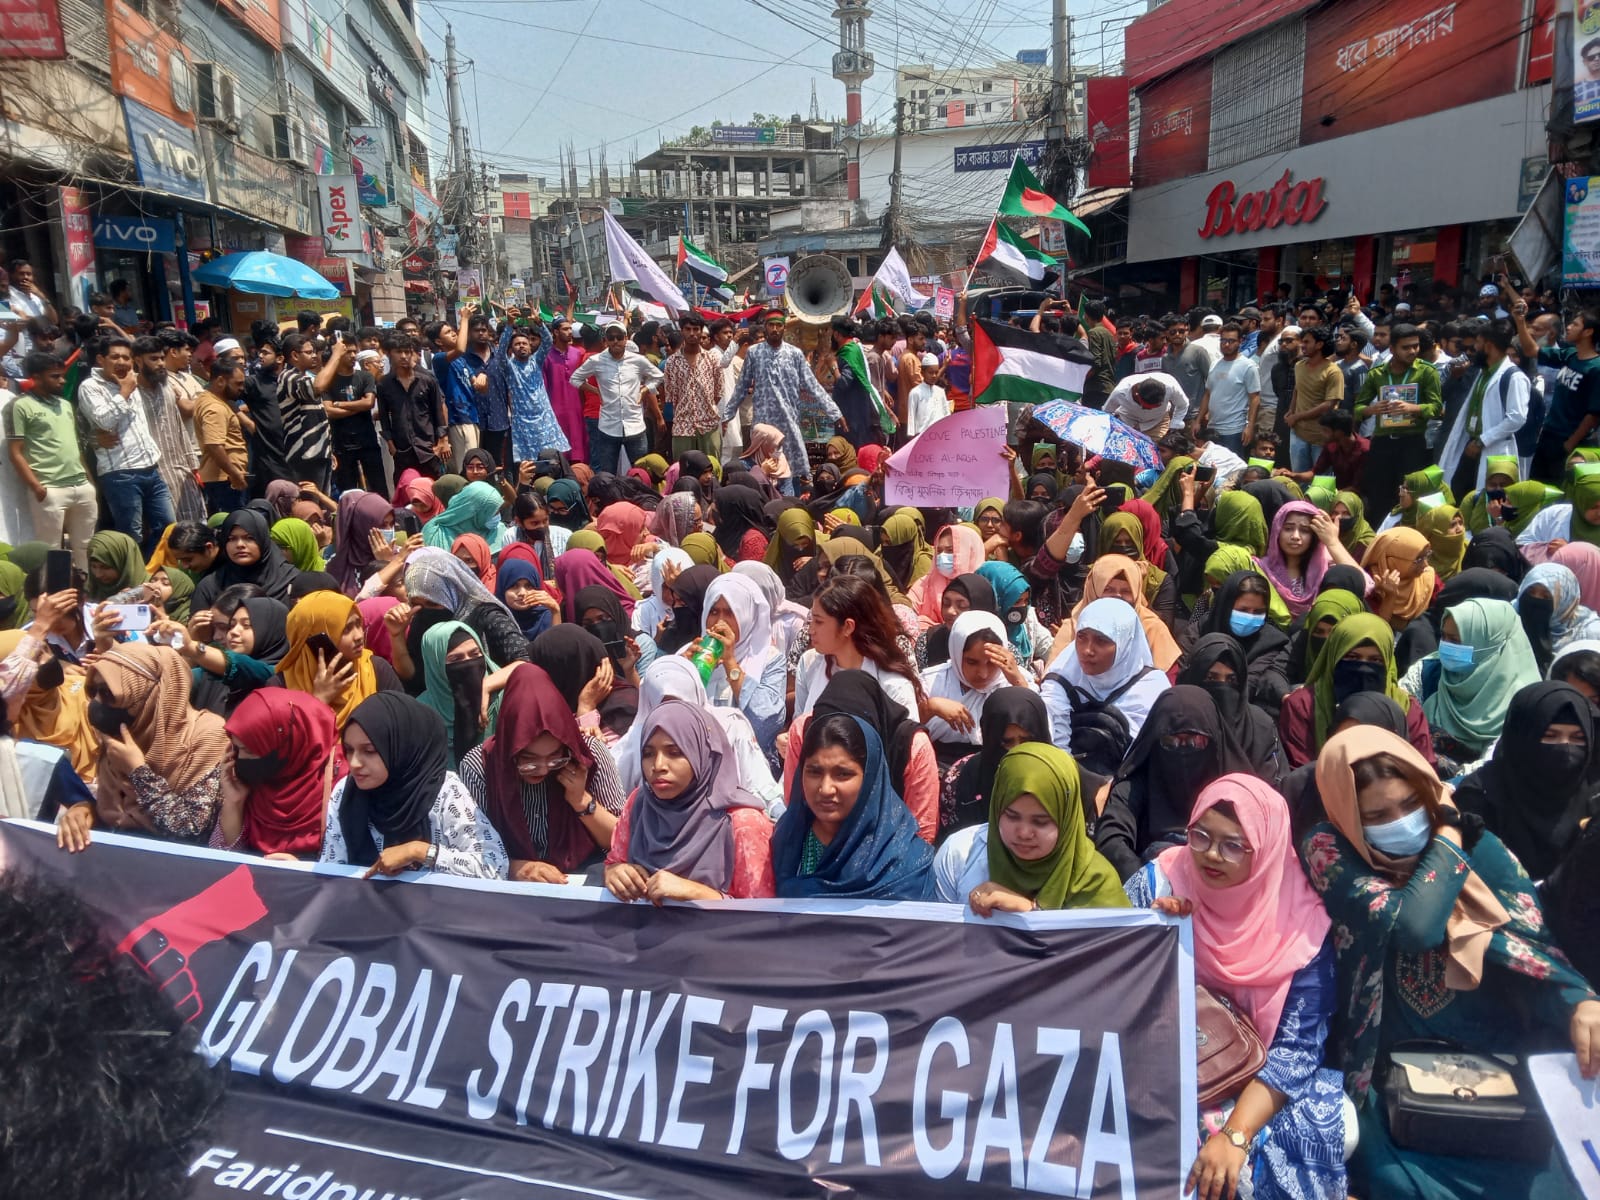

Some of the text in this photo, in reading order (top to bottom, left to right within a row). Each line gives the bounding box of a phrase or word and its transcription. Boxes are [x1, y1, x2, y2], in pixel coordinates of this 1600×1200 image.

[327, 186, 353, 240] Apex
[1198, 168, 1325, 239] Bata
[914, 454, 935, 463] LOVE
[960, 426, 1007, 440] PALESTINE
[194, 941, 1136, 1200] GLOBAL STRIKE FOR GAZA
